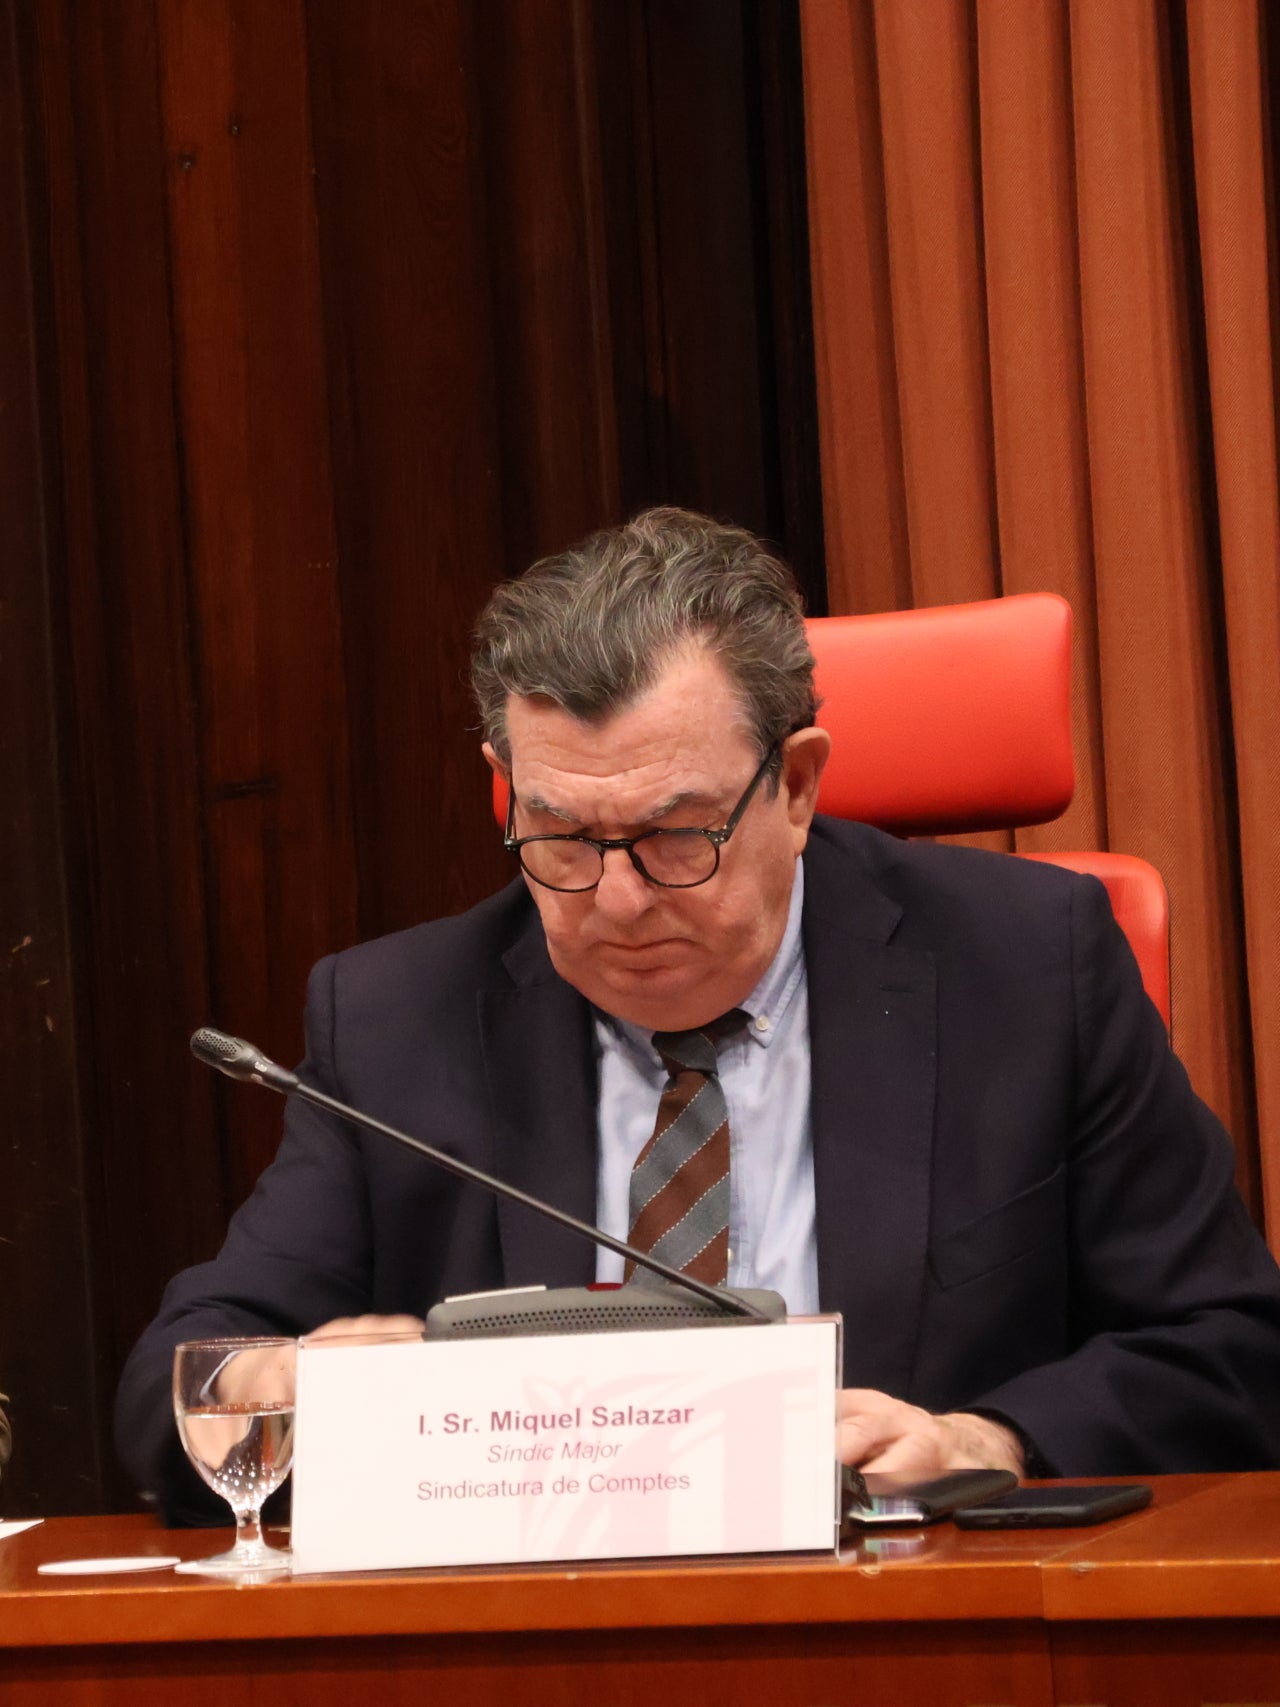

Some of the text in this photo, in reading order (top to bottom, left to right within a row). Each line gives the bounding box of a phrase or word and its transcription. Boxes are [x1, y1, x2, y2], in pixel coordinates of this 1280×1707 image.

[419, 1405, 695, 1435] I. Sr. Miquel Salazar
[487, 1440, 622, 1465] Síndic Major
[417, 1473, 691, 1501] Sindicatura de Comptes
